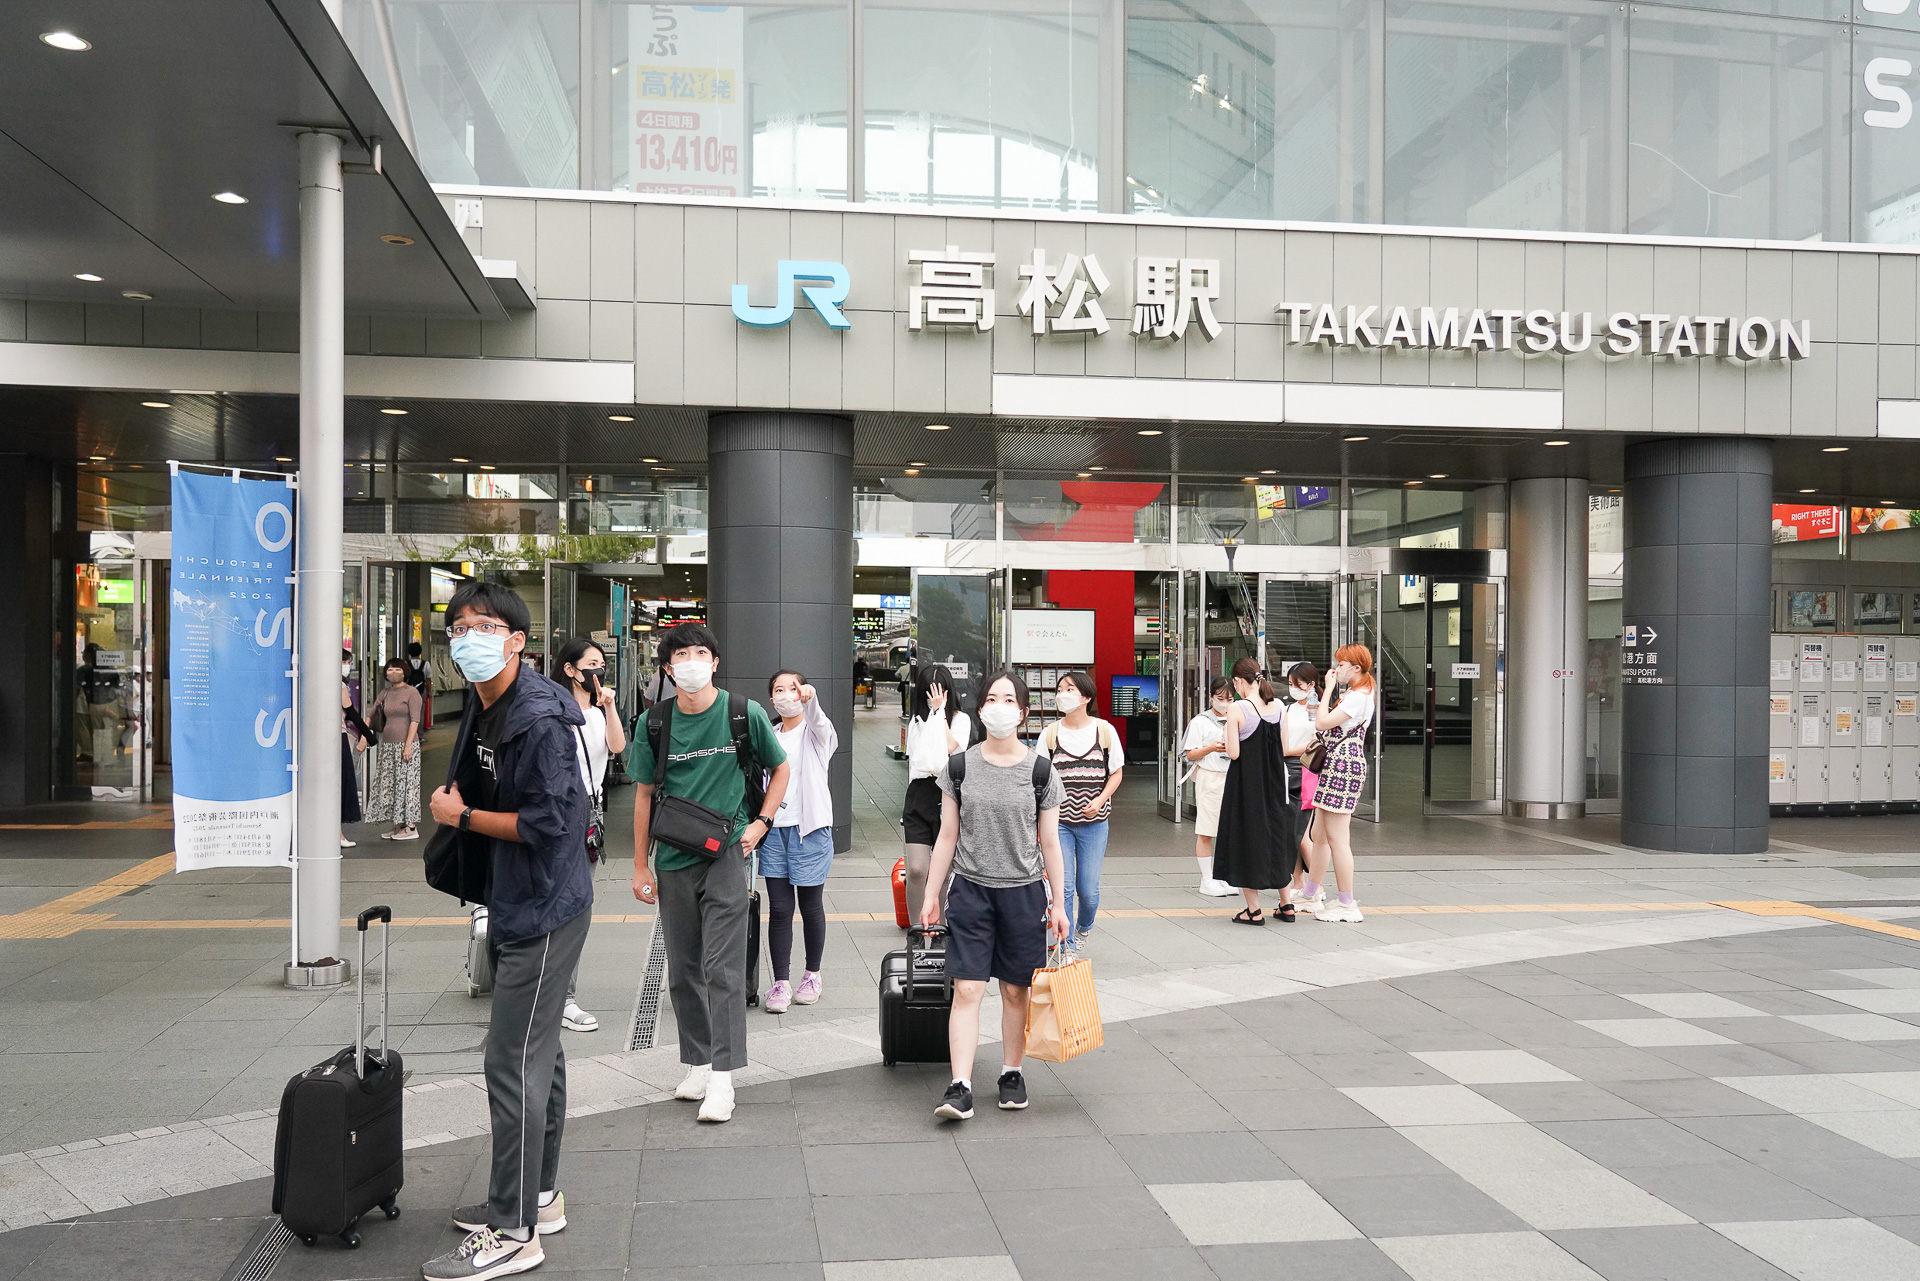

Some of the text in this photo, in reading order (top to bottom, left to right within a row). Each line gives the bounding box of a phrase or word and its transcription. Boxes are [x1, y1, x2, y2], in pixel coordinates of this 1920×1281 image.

[1863, 57, 1920, 129] S
[641, 112, 694, 128] 4日間用
[635, 133, 738, 175] 13,410円
[731, 245, 1224, 343] JR 高松駅
[1275, 301, 1811, 361] TAKAMATSU STATION
[1791, 508, 1832, 521] RIGHT THERE
[1811, 517, 1831, 527] すぐそこ
[1637, 668, 1658, 676] PORT
[667, 745, 737, 762] PORSCHE
